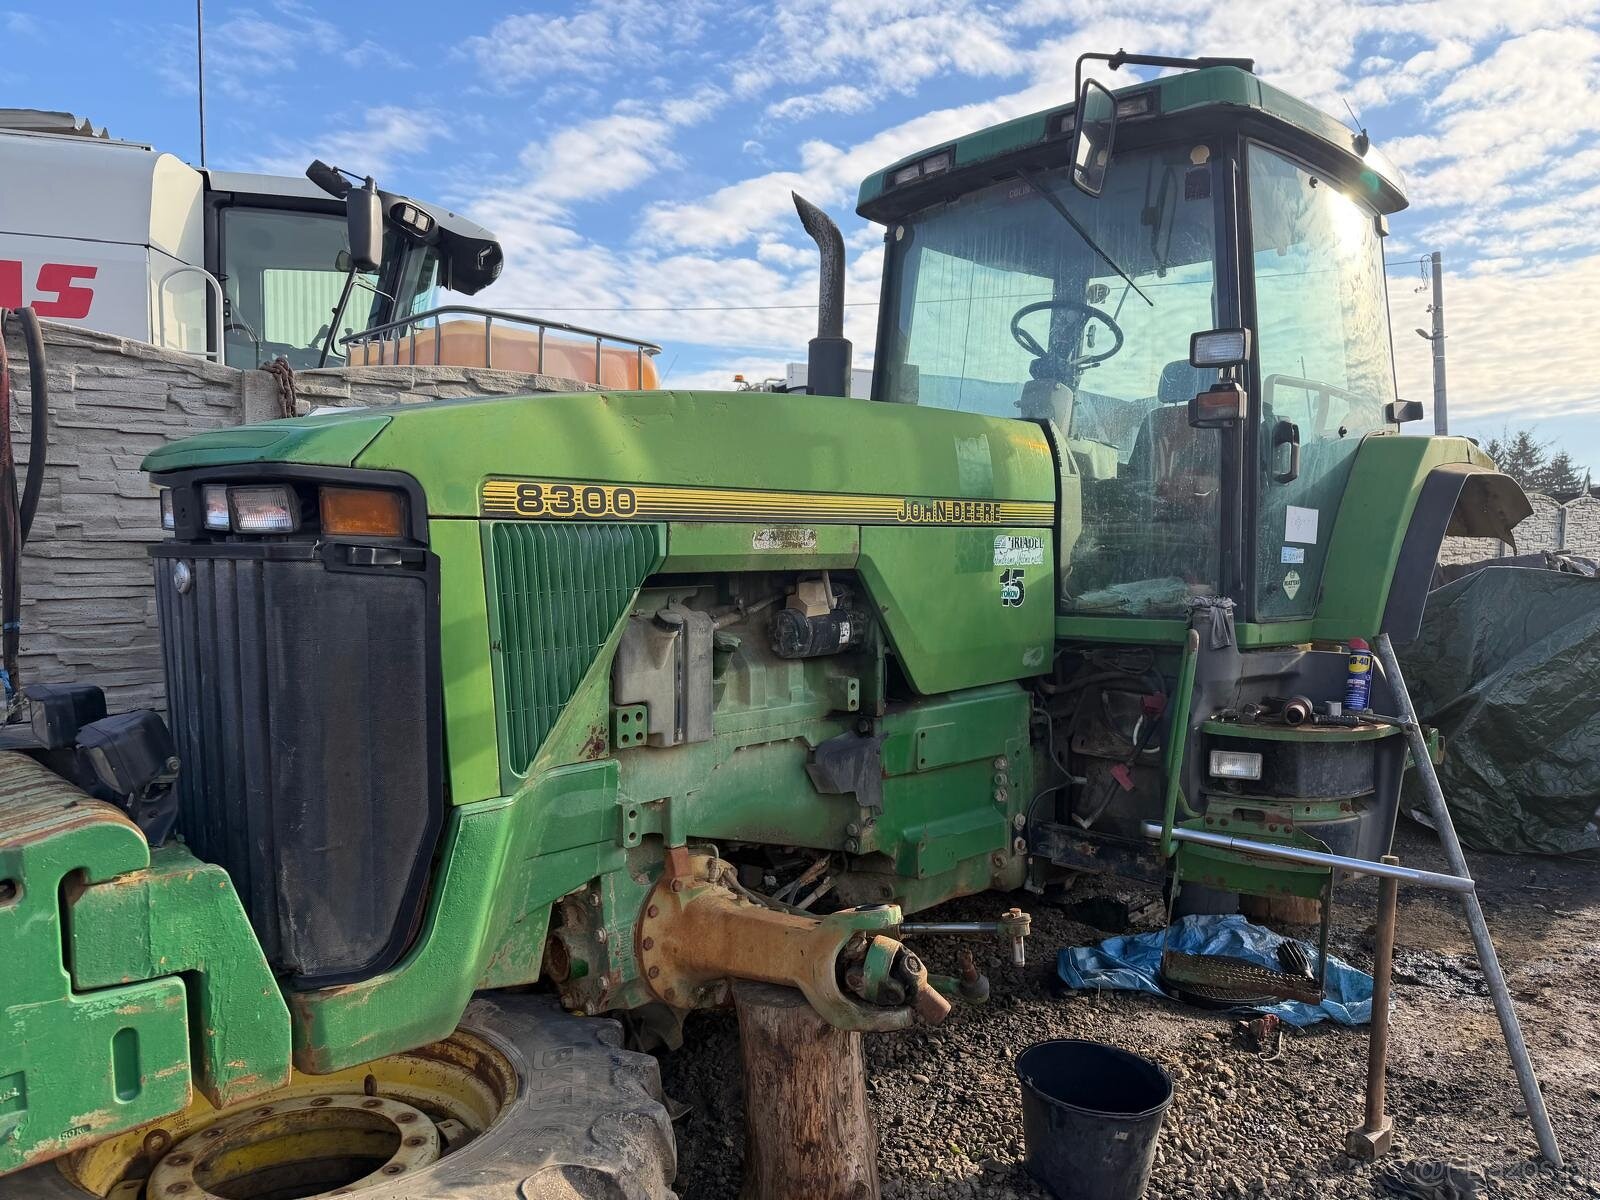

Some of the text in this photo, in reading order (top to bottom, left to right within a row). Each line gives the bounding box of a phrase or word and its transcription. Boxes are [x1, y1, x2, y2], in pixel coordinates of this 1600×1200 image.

[515, 483, 637, 516] 8300
[897, 500, 1001, 523] JOHN DEERE
